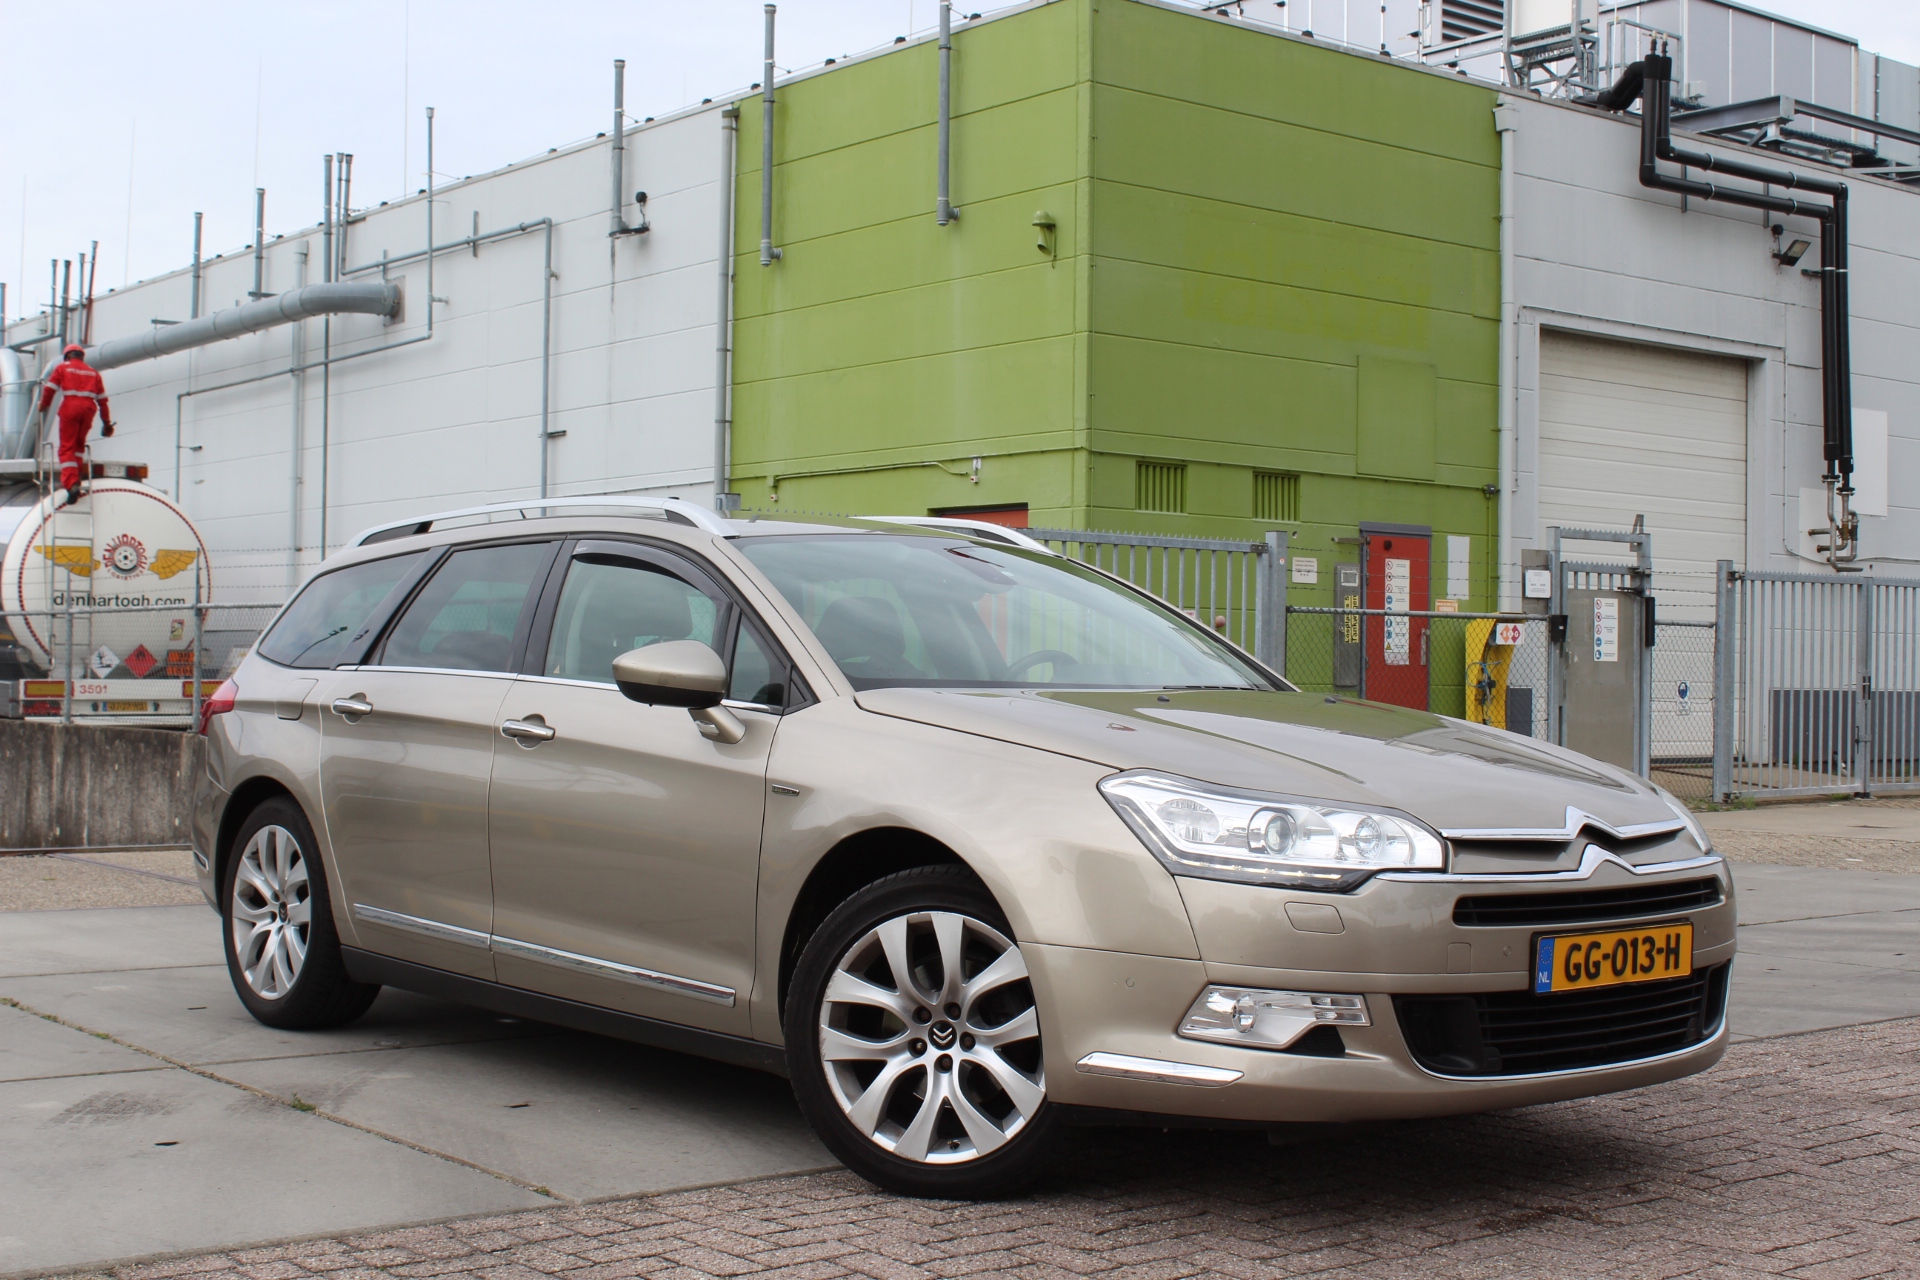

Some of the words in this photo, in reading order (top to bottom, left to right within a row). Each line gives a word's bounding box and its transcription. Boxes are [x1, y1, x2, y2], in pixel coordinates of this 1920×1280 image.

[80, 684, 108, 694] 3501
[1565, 933, 1681, 983] GG-013-H
[1538, 971, 1550, 984] NL
